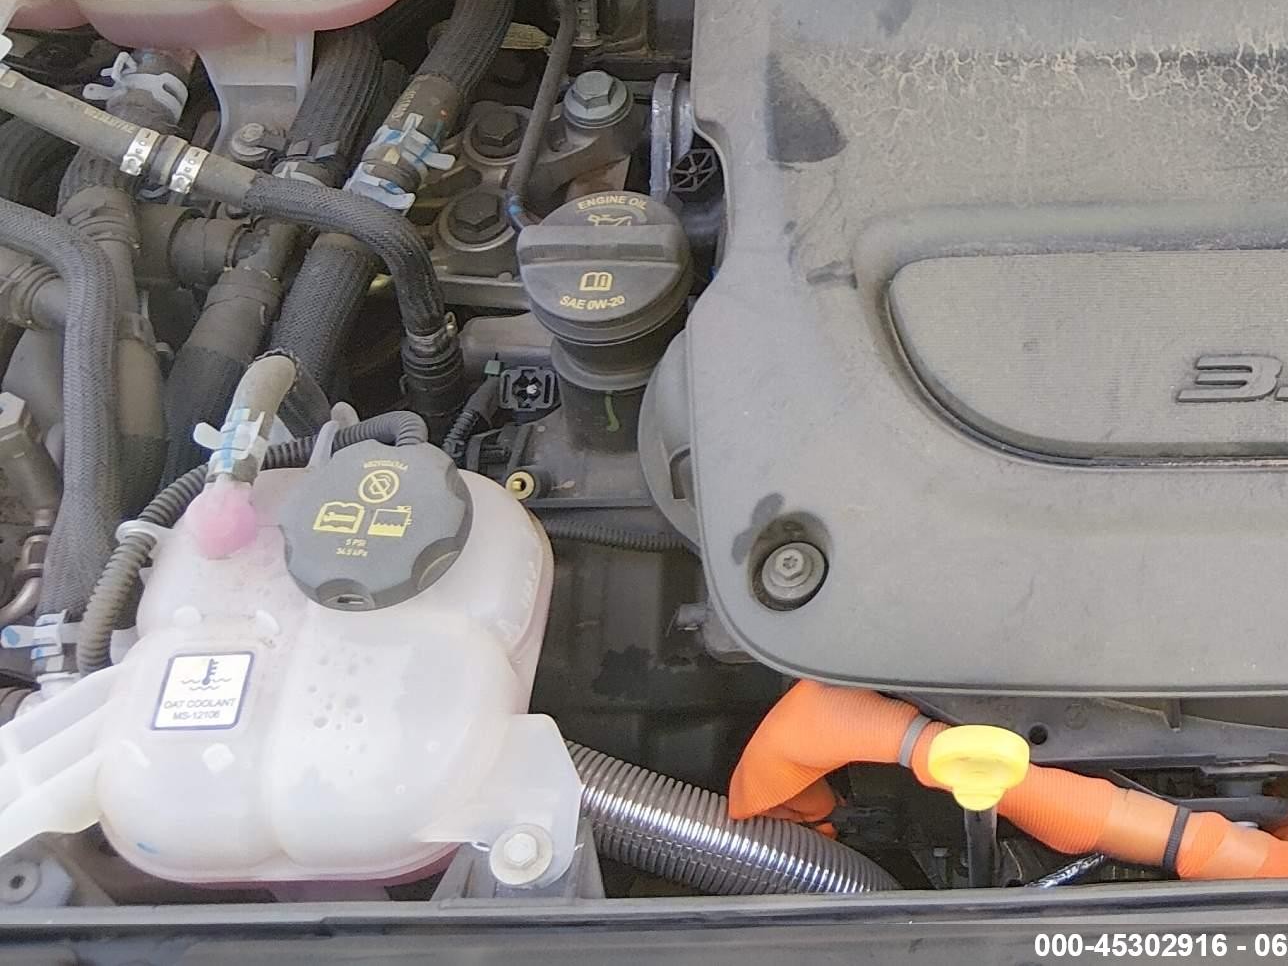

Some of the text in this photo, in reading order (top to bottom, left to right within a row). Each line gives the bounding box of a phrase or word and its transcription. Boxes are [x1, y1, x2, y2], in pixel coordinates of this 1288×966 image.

[577, 195, 648, 210] ENGINE OIL
[559, 295, 626, 310] SAE 0W-20
[186, 697, 237, 709] COOLANT
